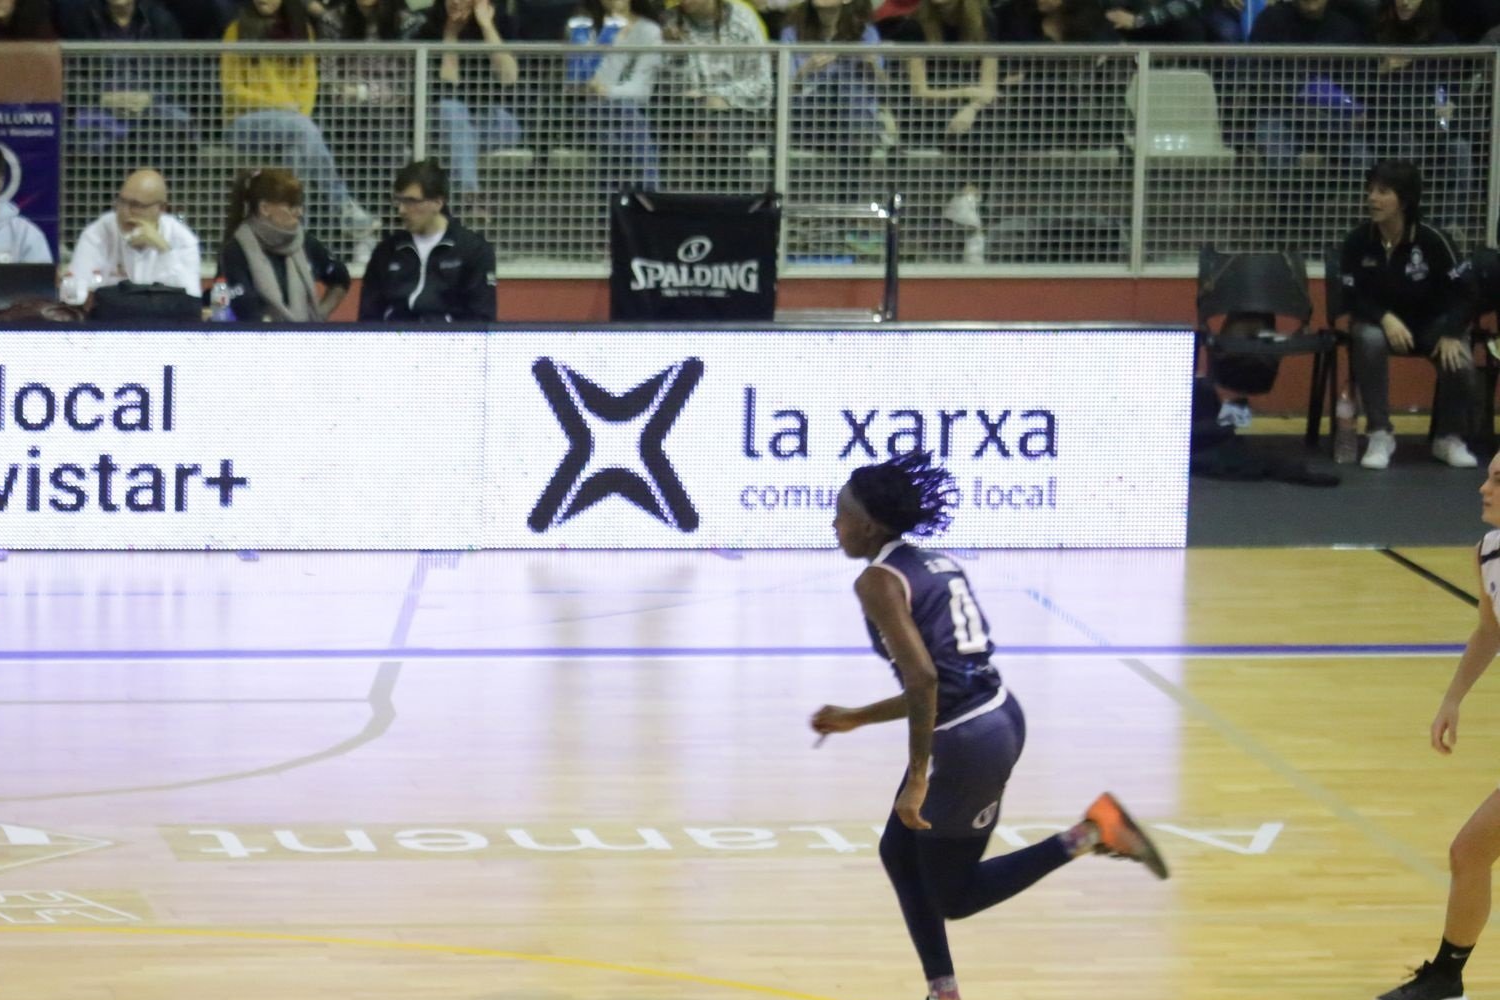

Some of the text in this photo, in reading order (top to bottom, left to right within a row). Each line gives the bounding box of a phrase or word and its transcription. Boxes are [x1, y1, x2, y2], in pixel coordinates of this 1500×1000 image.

[630, 257, 760, 293] SPALDING
[742, 386, 1059, 460] la xarxa
[973, 476, 1057, 510] local
